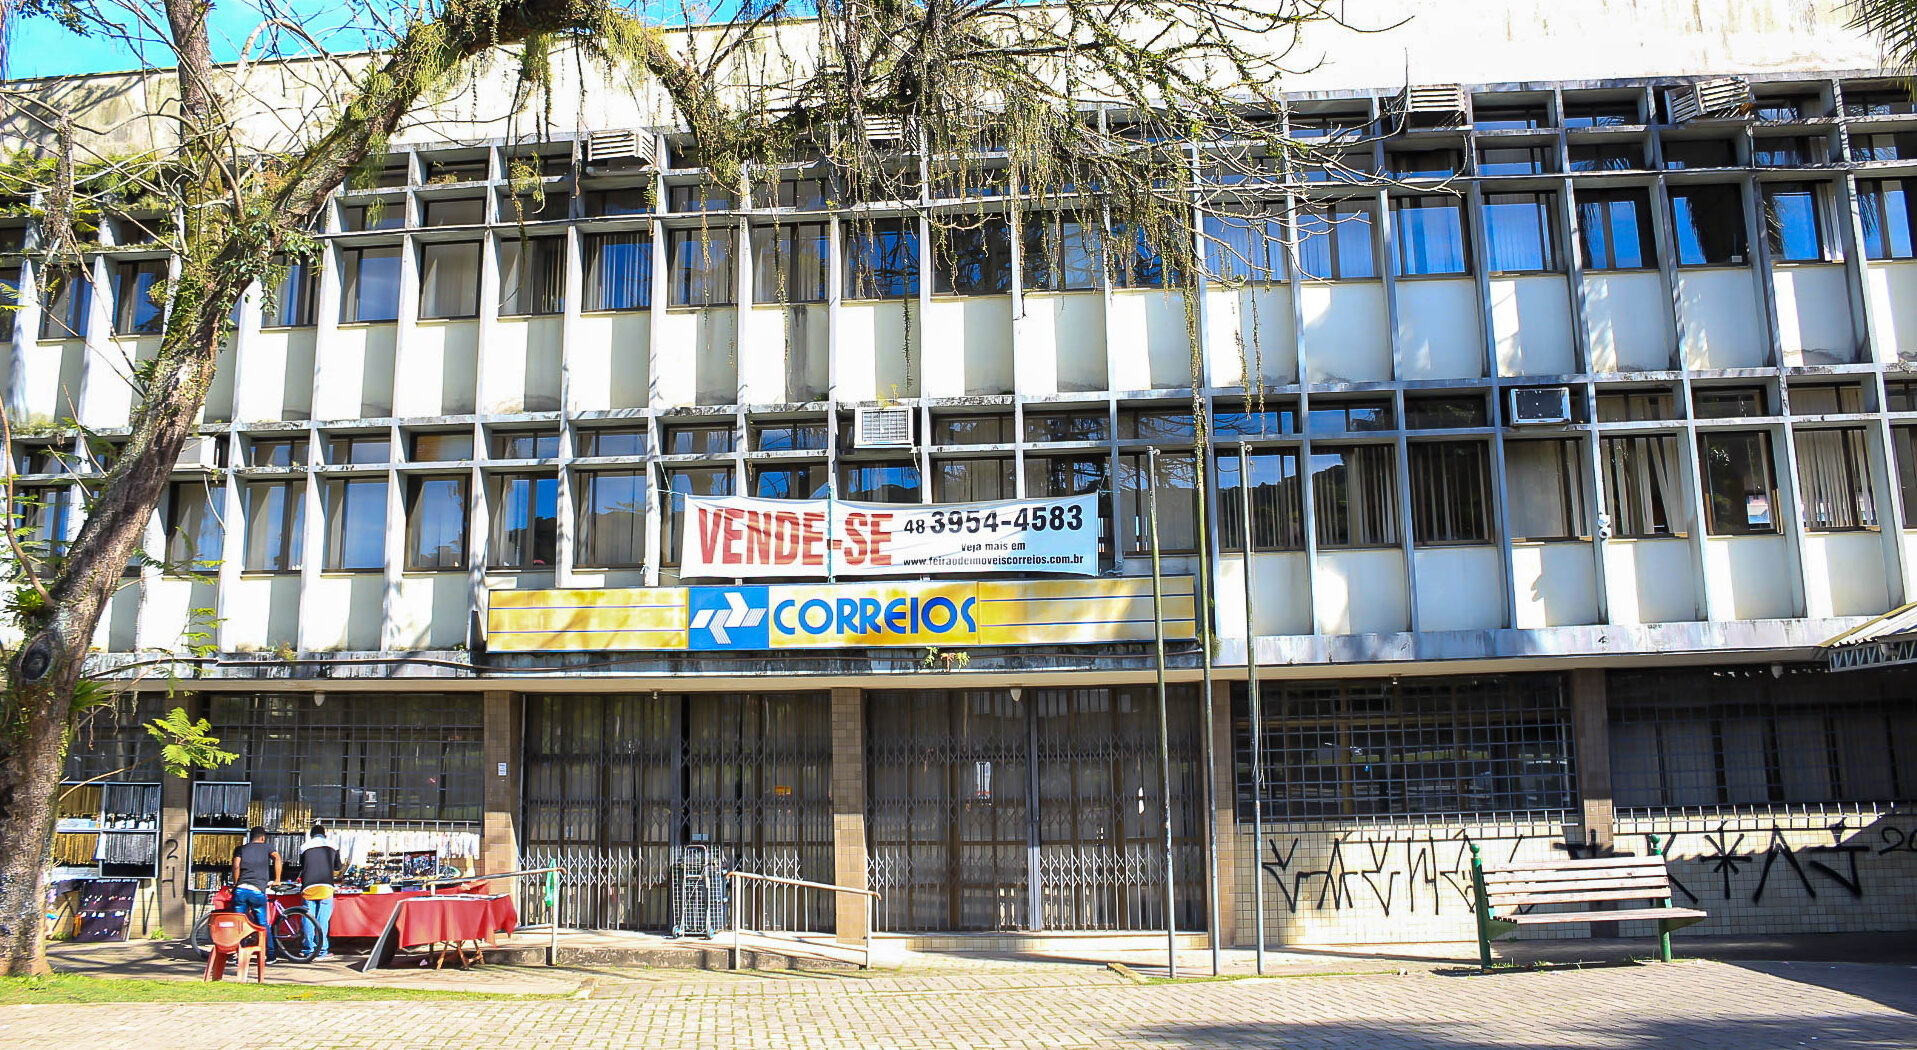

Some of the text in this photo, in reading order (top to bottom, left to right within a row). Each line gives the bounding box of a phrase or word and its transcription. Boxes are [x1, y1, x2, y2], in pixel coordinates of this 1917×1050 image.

[698, 507, 894, 566] VENDE-SE
[903, 504, 1083, 535] 48 3954-4583
[985, 541, 1008, 552] mais
[1011, 542, 1026, 551] em
[773, 596, 977, 636] CORREIOS
